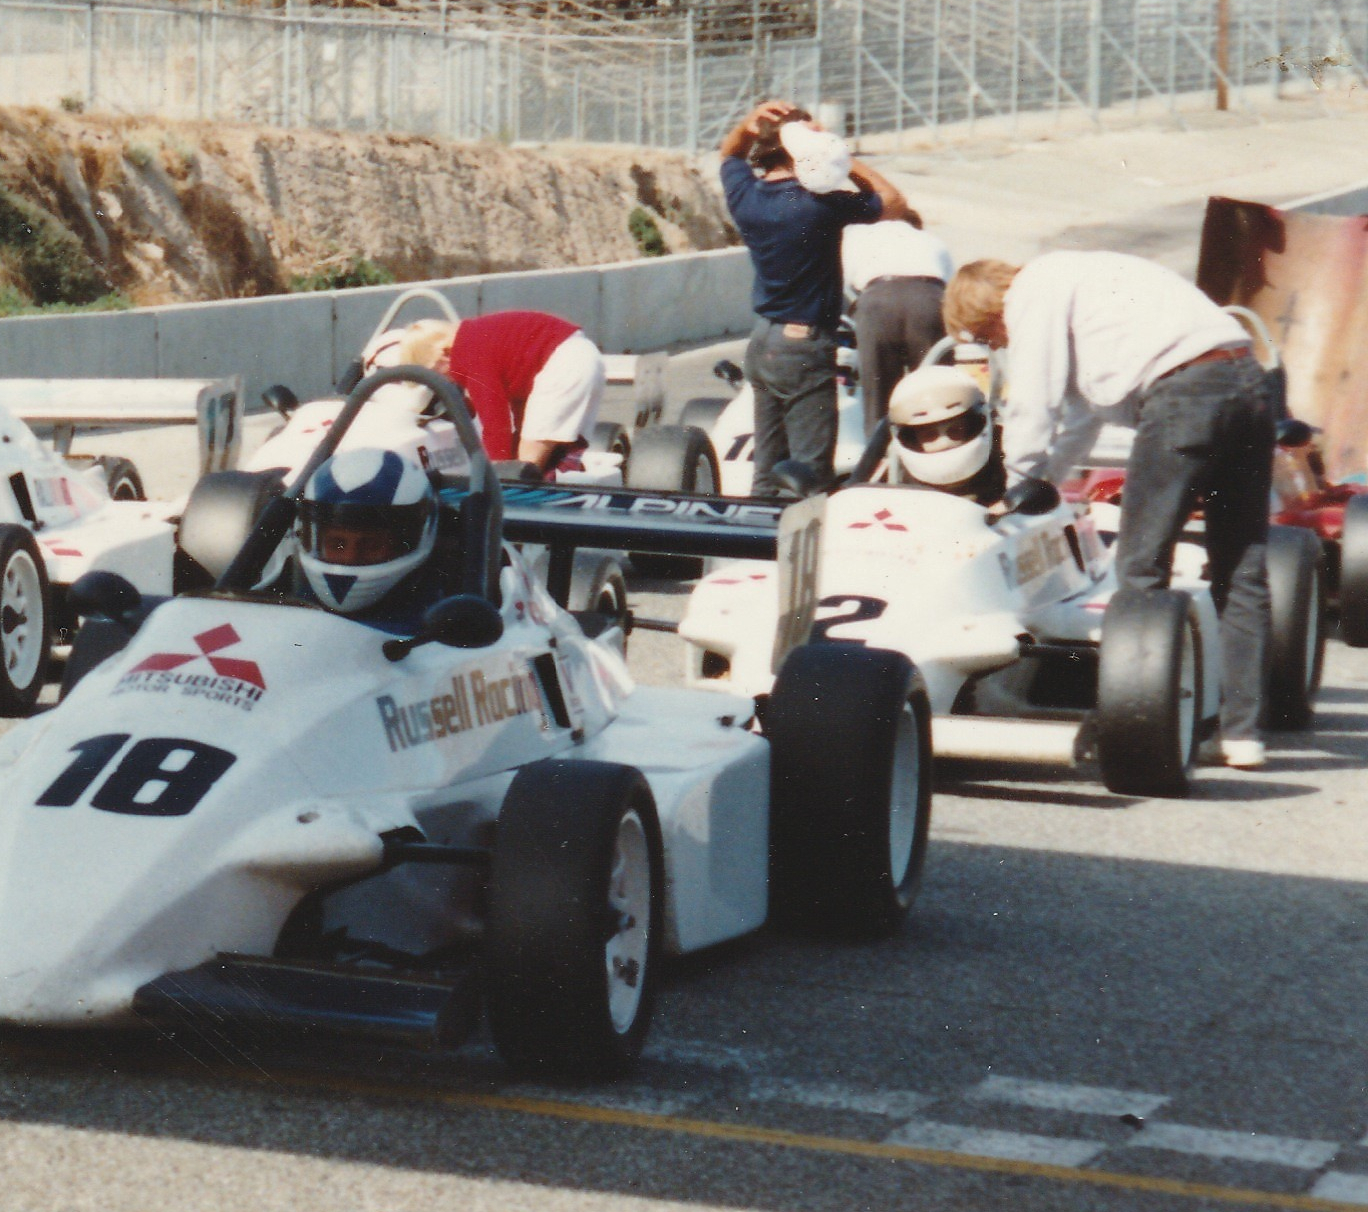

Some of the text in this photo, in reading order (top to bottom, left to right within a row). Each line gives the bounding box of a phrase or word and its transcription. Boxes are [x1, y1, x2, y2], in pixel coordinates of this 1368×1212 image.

[543, 494, 782, 522] ALPINE
[376, 673, 473, 752] Russell
[35, 732, 237, 817] 18
